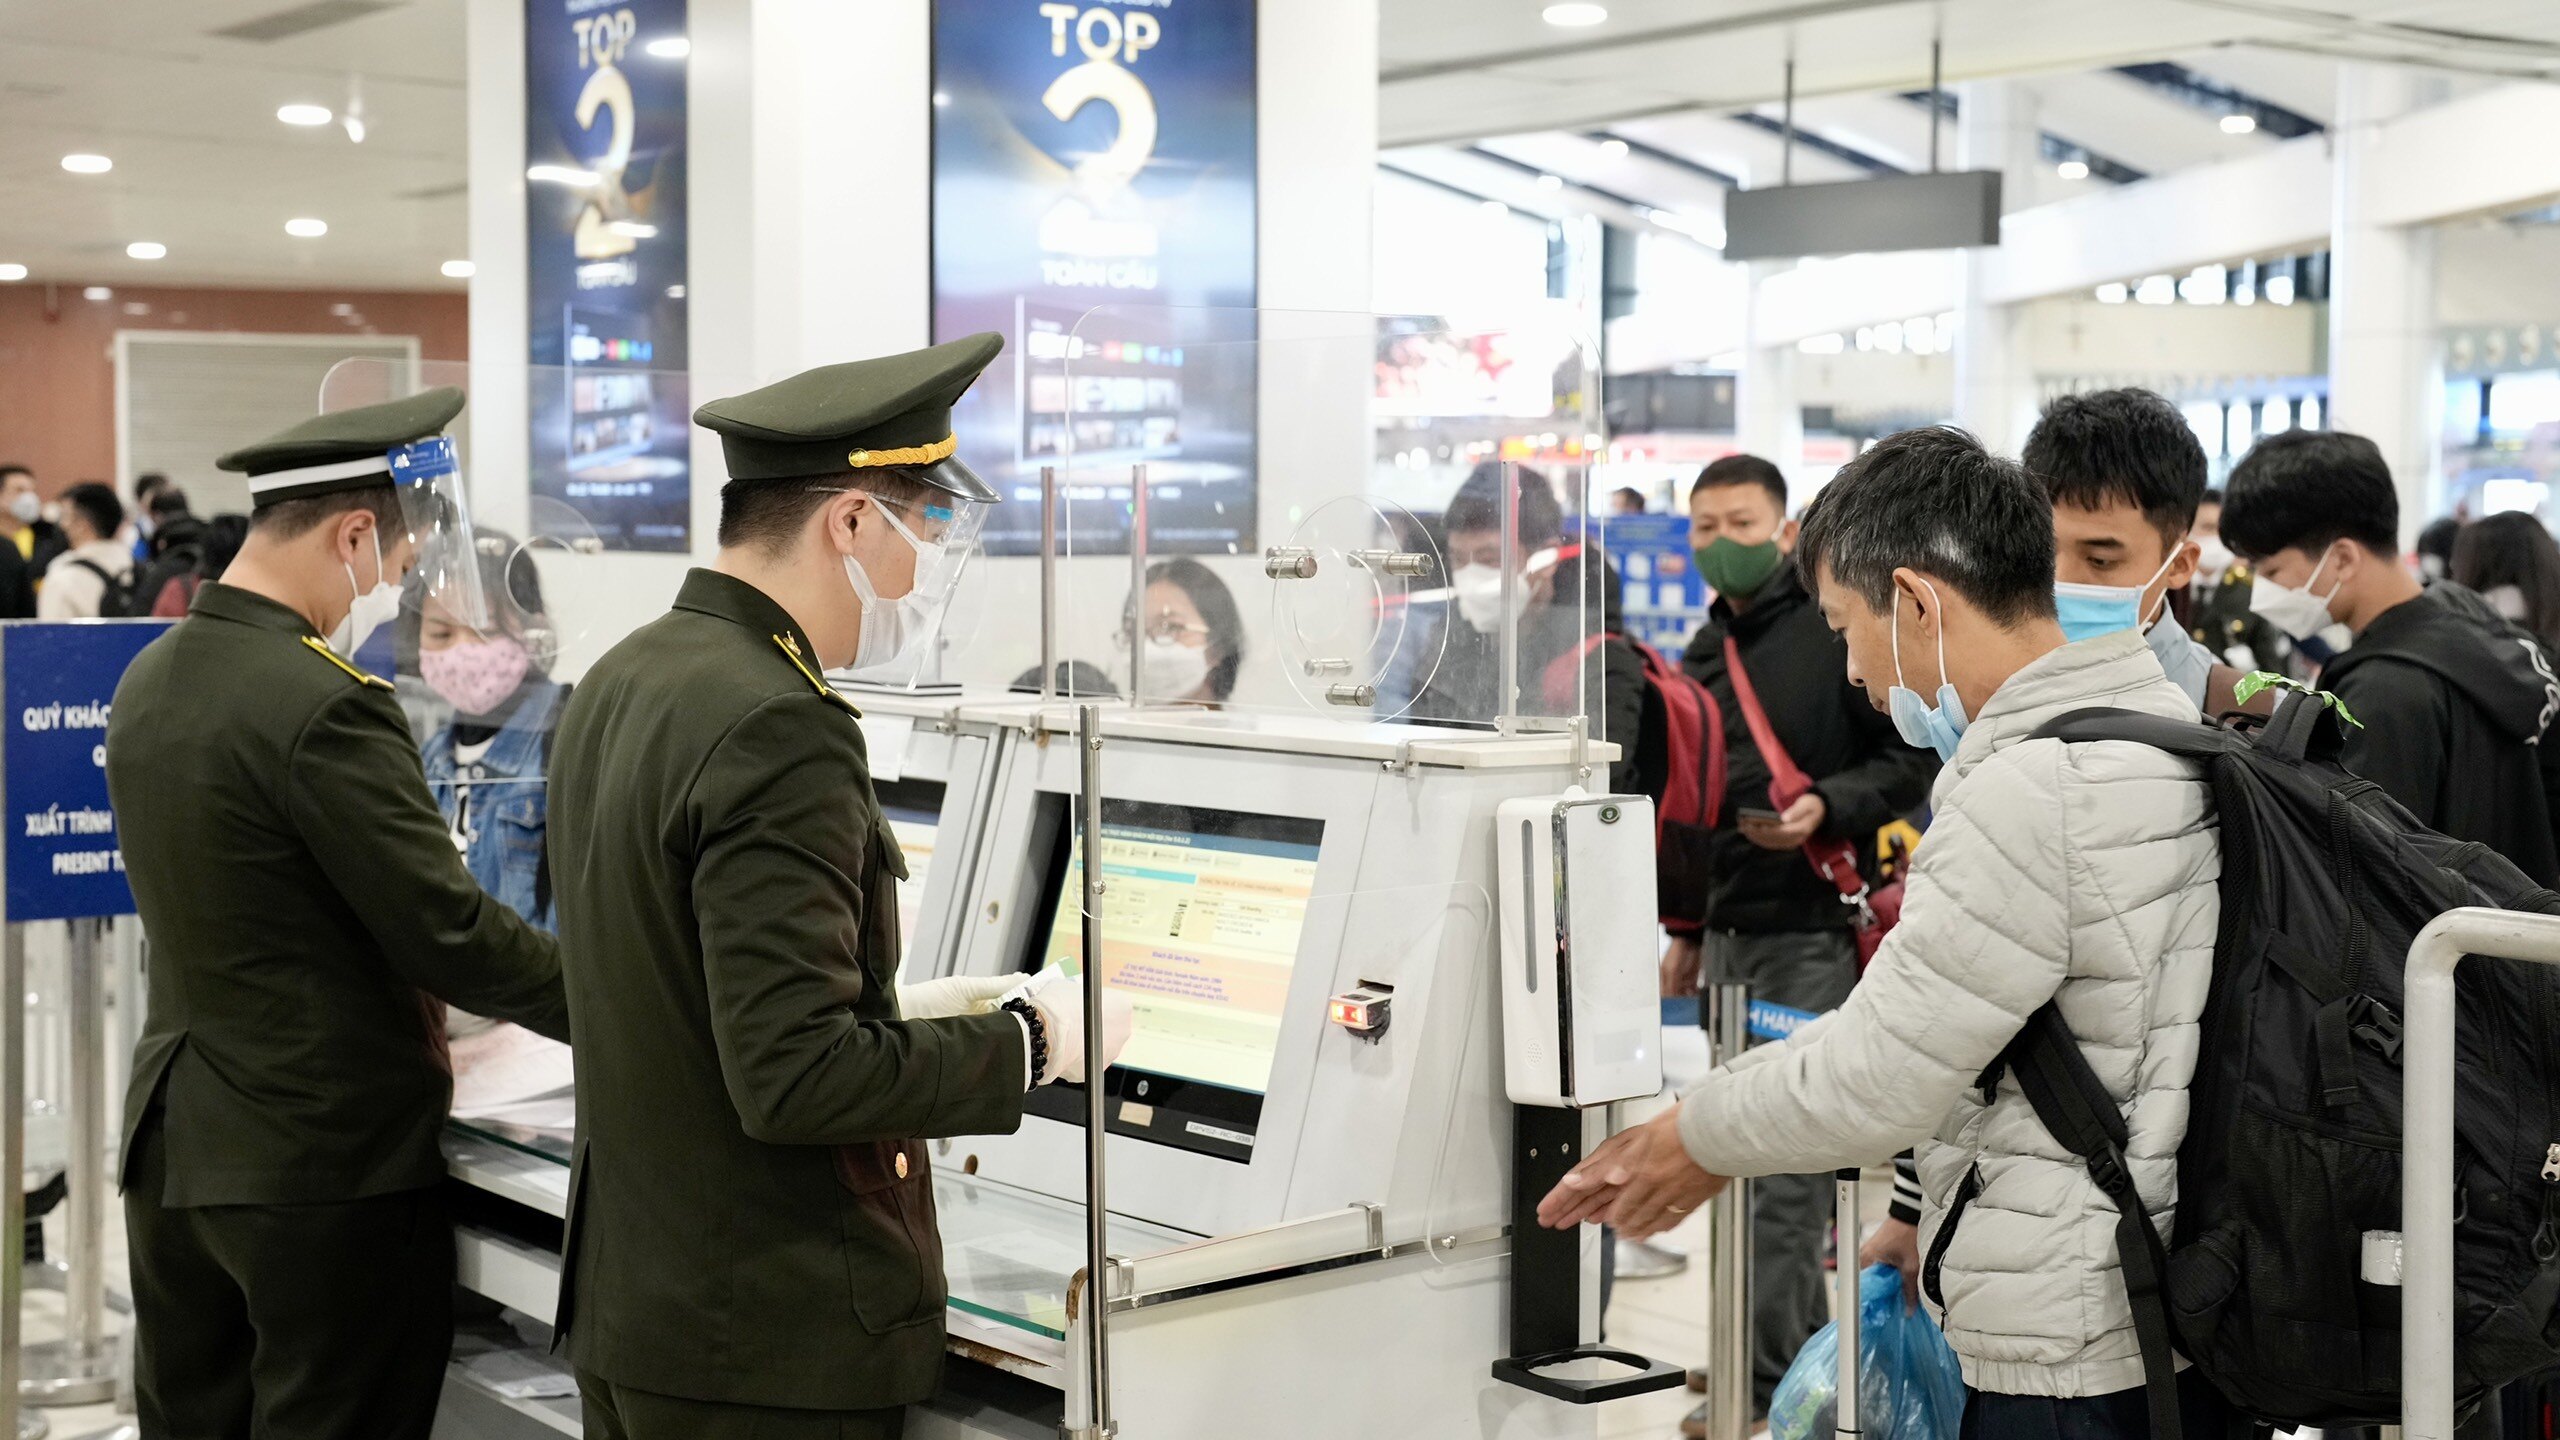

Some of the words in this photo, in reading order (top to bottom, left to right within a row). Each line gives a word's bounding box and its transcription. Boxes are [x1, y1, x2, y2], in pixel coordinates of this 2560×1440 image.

[572, 9, 636, 69] TOP
[1040, 2, 1160, 64] TOP
[574, 65, 636, 258] 2
[1041, 60, 1159, 254] 2
[23, 700, 63, 732] QUÝ
[52, 851, 111, 876] PRESENT
